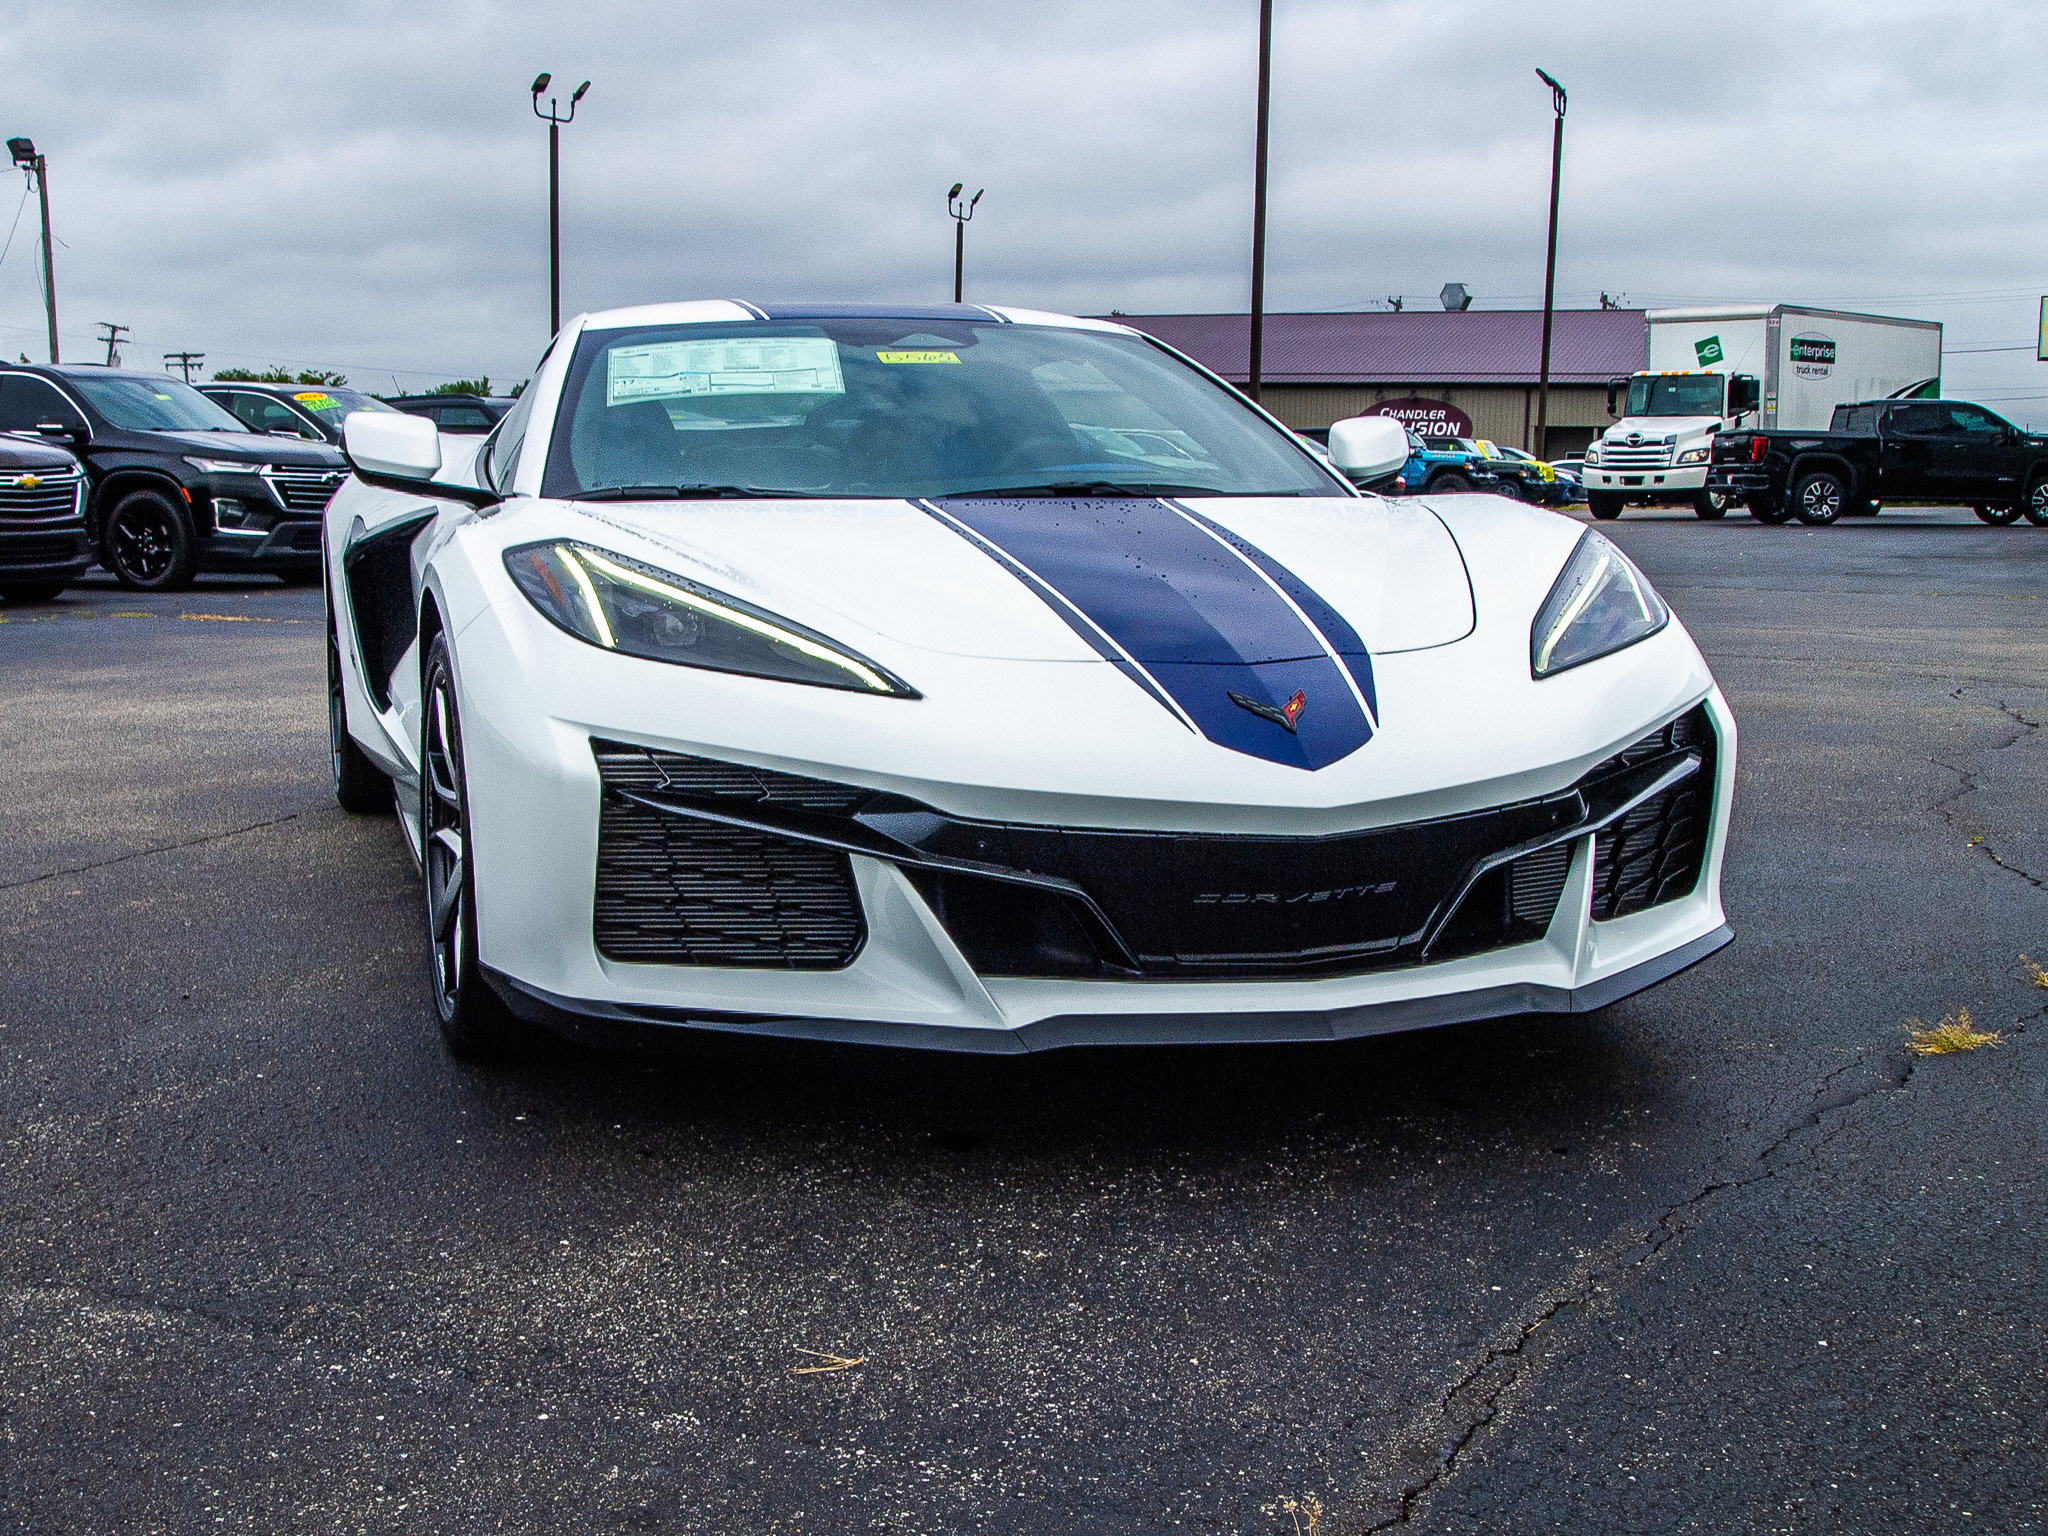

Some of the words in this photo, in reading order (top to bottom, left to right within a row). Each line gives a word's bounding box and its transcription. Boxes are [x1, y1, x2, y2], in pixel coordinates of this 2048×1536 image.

[1791, 344, 1835, 361] enterprise
[1796, 365, 1811, 375] truck
[1811, 366, 1829, 376] rental
[1380, 408, 1446, 420] CHANDLER
[1402, 421, 1461, 436] ISION
[1193, 881, 1397, 903] CORVETTE
